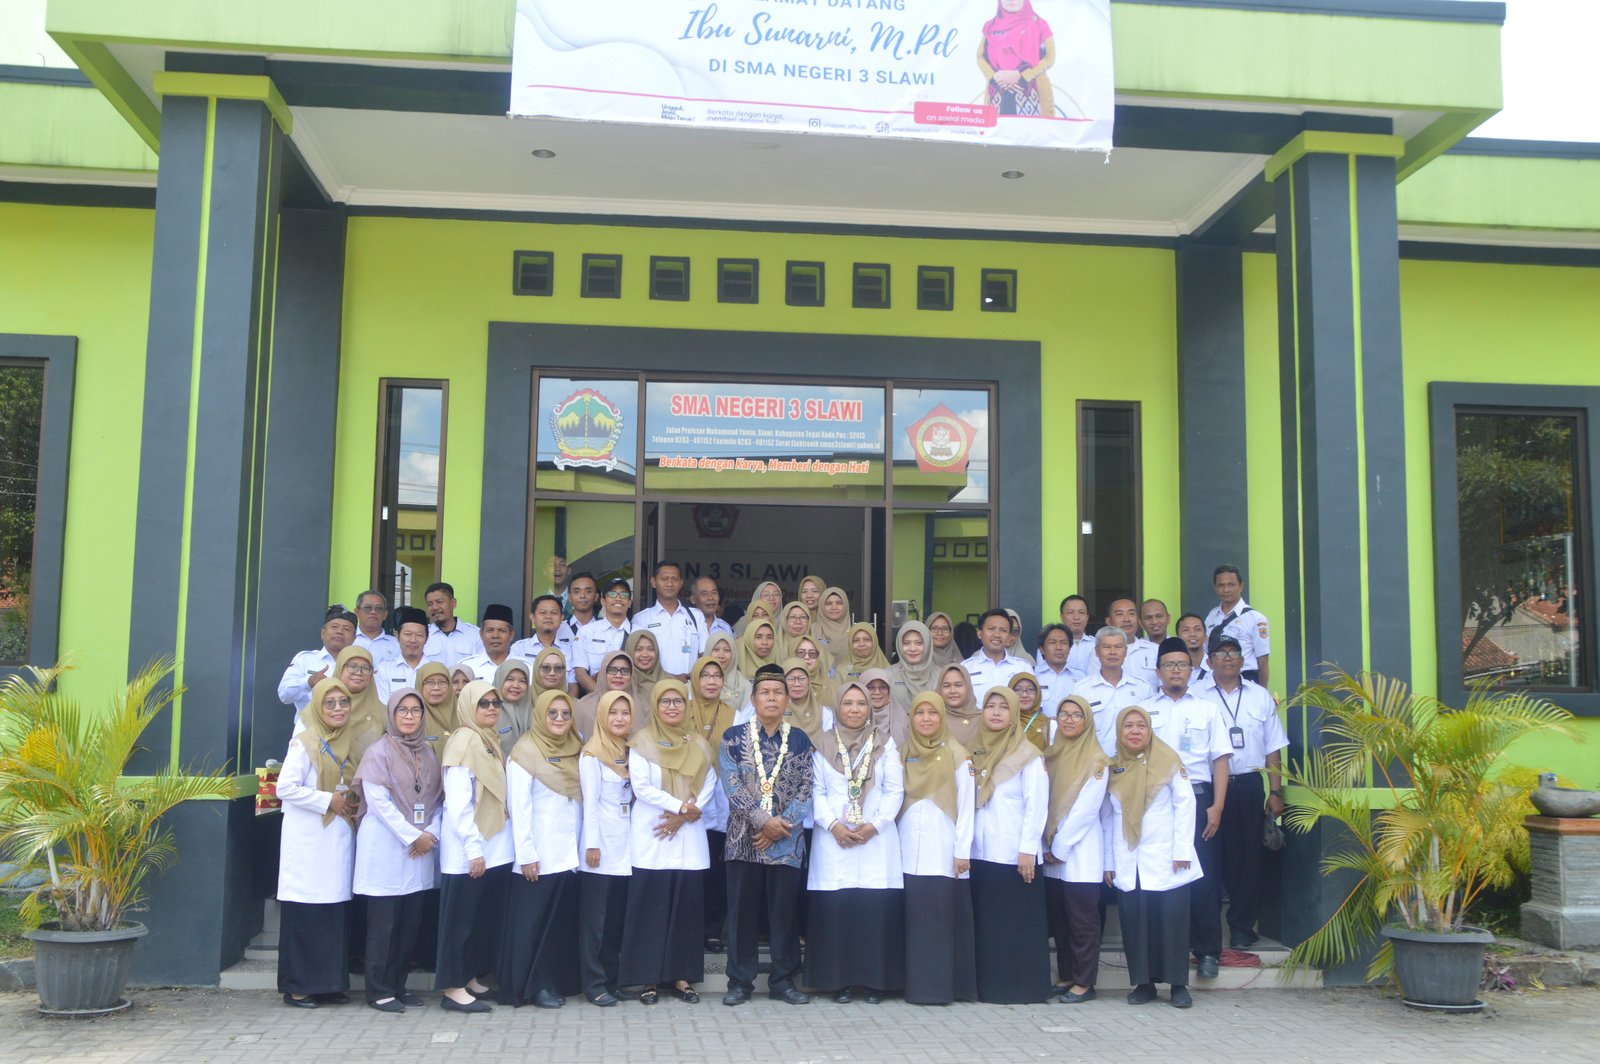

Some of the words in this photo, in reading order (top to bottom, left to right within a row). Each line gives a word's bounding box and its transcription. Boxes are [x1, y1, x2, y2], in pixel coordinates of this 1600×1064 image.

[678, 3, 735, 40] Ibu
[744, 12, 857, 54] Sunarni,
[870, 21, 959, 60] M.Pd
[709, 59, 727, 72] DI
[734, 60, 777, 75] SMA
[783, 64, 852, 82] NEGERI
[859, 69, 869, 83] 3
[876, 70, 935, 85] SLAWI
[707, 108, 733, 116] Berkata
[736, 110, 761, 119] dengan
[946, 105, 970, 114] Follow
[961, 117, 985, 125] media
[671, 395, 711, 416] SMA
[716, 396, 785, 419] NEGERI
[788, 399, 801, 420] 3
[805, 400, 863, 422] SLAWI
[659, 456, 697, 469] Berkata
[698, 457, 734, 472] dengan
[735, 458, 767, 474] Karya,
[767, 459, 811, 472] Memberi
[812, 460, 847, 475] dengan
[848, 461, 870, 473] Hati
[709, 562, 721, 580] 3
[730, 563, 808, 582] SLAWI
